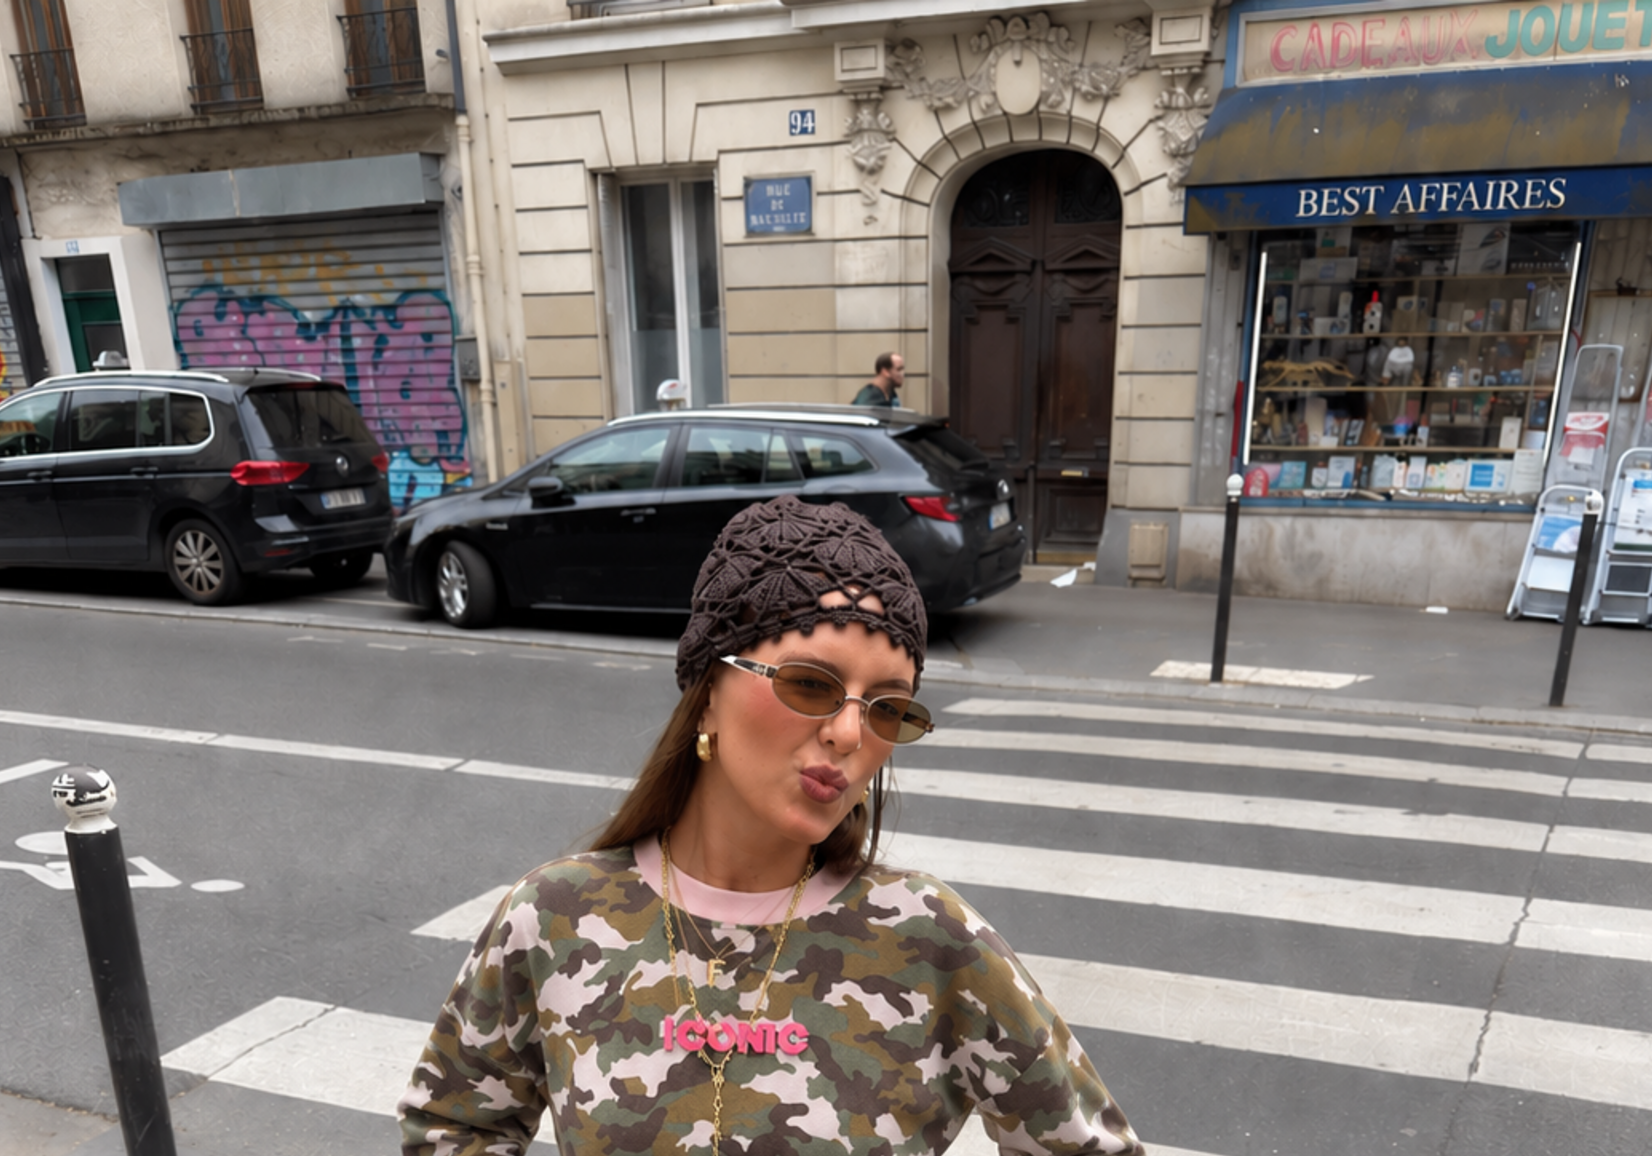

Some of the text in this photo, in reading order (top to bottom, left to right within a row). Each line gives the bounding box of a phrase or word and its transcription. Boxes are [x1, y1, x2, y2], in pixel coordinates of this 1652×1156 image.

[1270, 9, 1479, 71] CADEAUX
[791, 112, 814, 134] 94
[1295, 178, 1566, 218] BEST AFFAIRES
[663, 1014, 809, 1055] ICONIC
